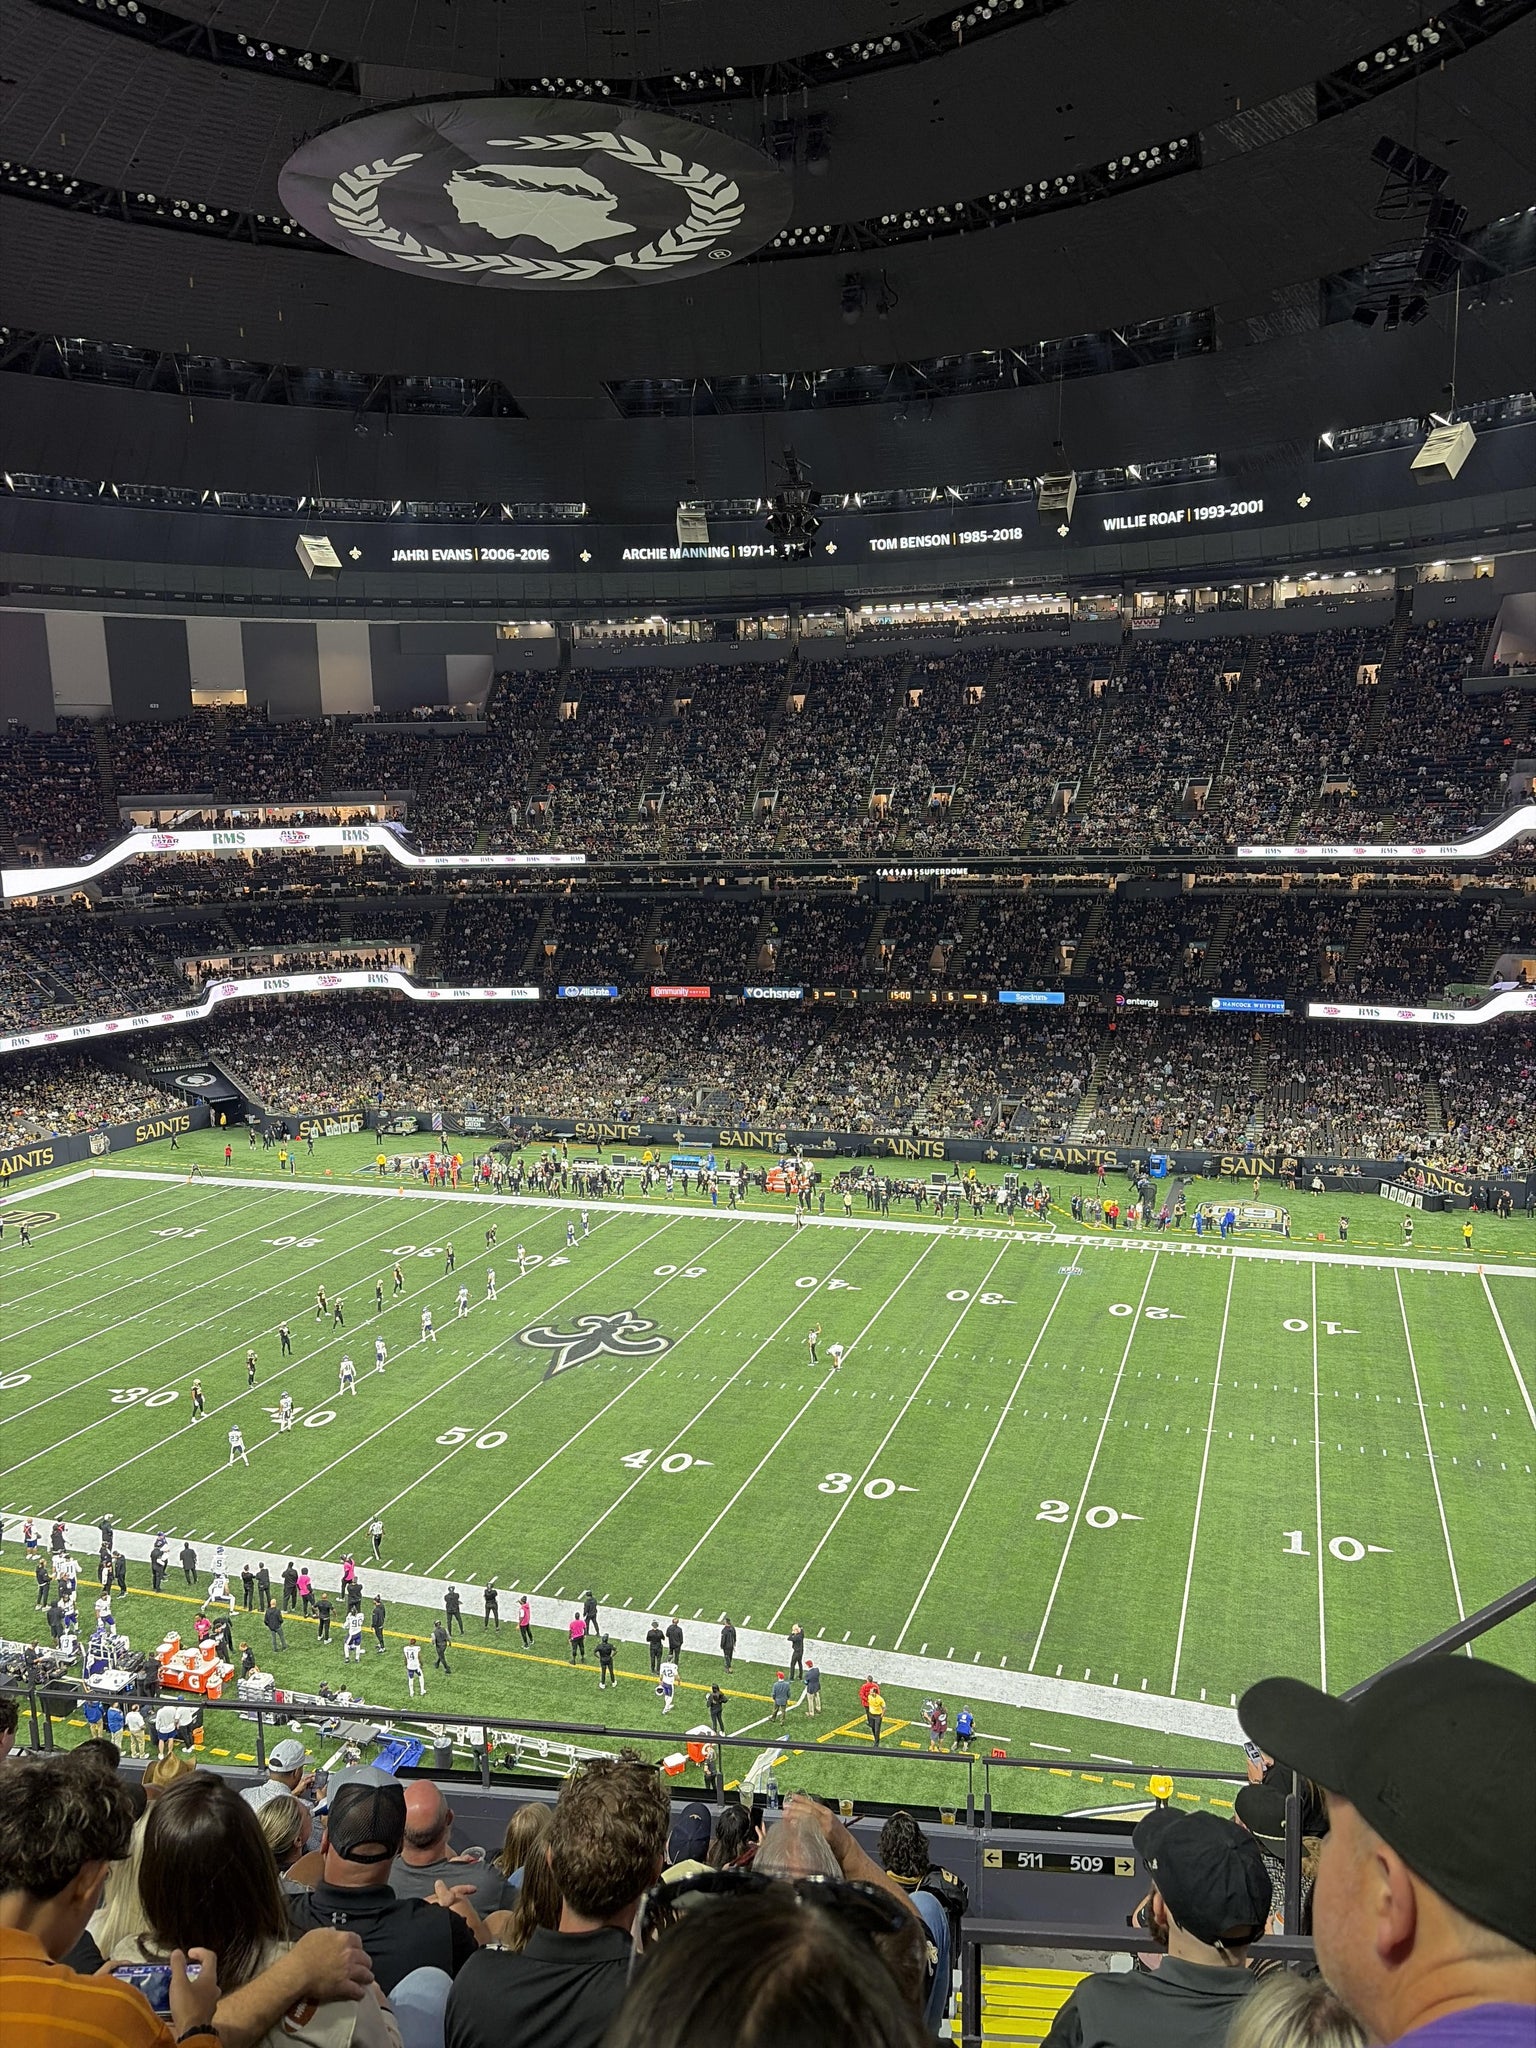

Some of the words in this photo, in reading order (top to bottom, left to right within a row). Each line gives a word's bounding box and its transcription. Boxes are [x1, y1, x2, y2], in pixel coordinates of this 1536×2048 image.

[1103, 513, 1147, 531] WILLIE
[1149, 510, 1185, 526] ROAF
[1193, 500, 1264, 521] 1993-2001
[869, 538, 898, 551] TOM
[900, 535, 950, 549] BENSON
[958, 527, 1023, 544] 1985-2018
[392, 549, 429, 561] JAHRI
[432, 548, 473, 561] EVANS
[481, 548, 550, 561] 2006-2016
[622, 548, 668, 560] ARCHIE
[669, 546, 730, 559] MANNING
[212, 832, 246, 845] RMS
[342, 829, 370, 841] RMS
[784, 851, 813, 860] SAINTS
[848, 851, 877, 859] SAINTS
[912, 850, 943, 858] SAINTS
[979, 849, 1010, 857] SAINTS
[1048, 848, 1079, 856] SAINTS
[1118, 848, 1153, 856] SAINTS
[1191, 847, 1226, 855] SAINTS
[597, 854, 625, 862] SAINTS
[659, 853, 687, 861] SAINTS
[721, 852, 749, 860] SAINTS
[919, 867, 968, 875] SUPERDOME
[993, 867, 1023, 875] SAINTS
[1058, 866, 1089, 875] SAINTS
[1125, 866, 1156, 874] SAINTS
[1195, 866, 1226, 874] SAINTS
[1266, 866, 1299, 874] SAINTS
[1340, 866, 1374, 874] SAINTS
[1417, 866, 1452, 874] SAINTS
[1498, 866, 1536, 875] SAINTS
[368, 973, 389, 984] RMS
[263, 978, 290, 990] RMS
[453, 989, 471, 997] RMS
[511, 989, 528, 997] RMS
[579, 987, 611, 996] Allstate
[621, 987, 649, 996] SAINTS
[654, 986, 689, 997] Community
[753, 988, 801, 999] Ochsner
[890, 991, 911, 1000] 15:00
[1015, 993, 1047, 1002] Spectrum
[1068, 994, 1099, 1003] SAINTS
[1126, 998, 1159, 1007] entergy
[186, 1009, 200, 1018] RMS
[1358, 1008, 1380, 1017] RMS
[1432, 1011, 1456, 1020] RMS
[132, 1017, 149, 1026] RMS
[73, 1027, 91, 1036] RMS
[11, 1037, 30, 1047] RMS
[136, 1115, 191, 1143] SAINTS
[575, 1122, 640, 1140] SAINTS
[719, 1130, 786, 1147] SAINTS
[0, 1147, 54, 1176] AINTS
[944, 1227, 1048, 1240] CANCER
[1068, 1236, 1232, 1255] INTERCEPT
[653, 1265, 708, 1278] 50
[795, 1277, 850, 1291] 40
[946, 1290, 1005, 1305] 30
[1108, 1303, 1170, 1320] 20
[1283, 1318, 1344, 1335] 10
[111, 1387, 179, 1407] 30
[435, 1427, 508, 1449] 50
[620, 1449, 693, 1473] 40
[818, 1473, 896, 1499] 30
[1036, 1500, 1119, 1529] 20
[1282, 1530, 1366, 1562] 10
[1017, 1852, 1043, 1869] 511
[1069, 1856, 1104, 1872] 509
